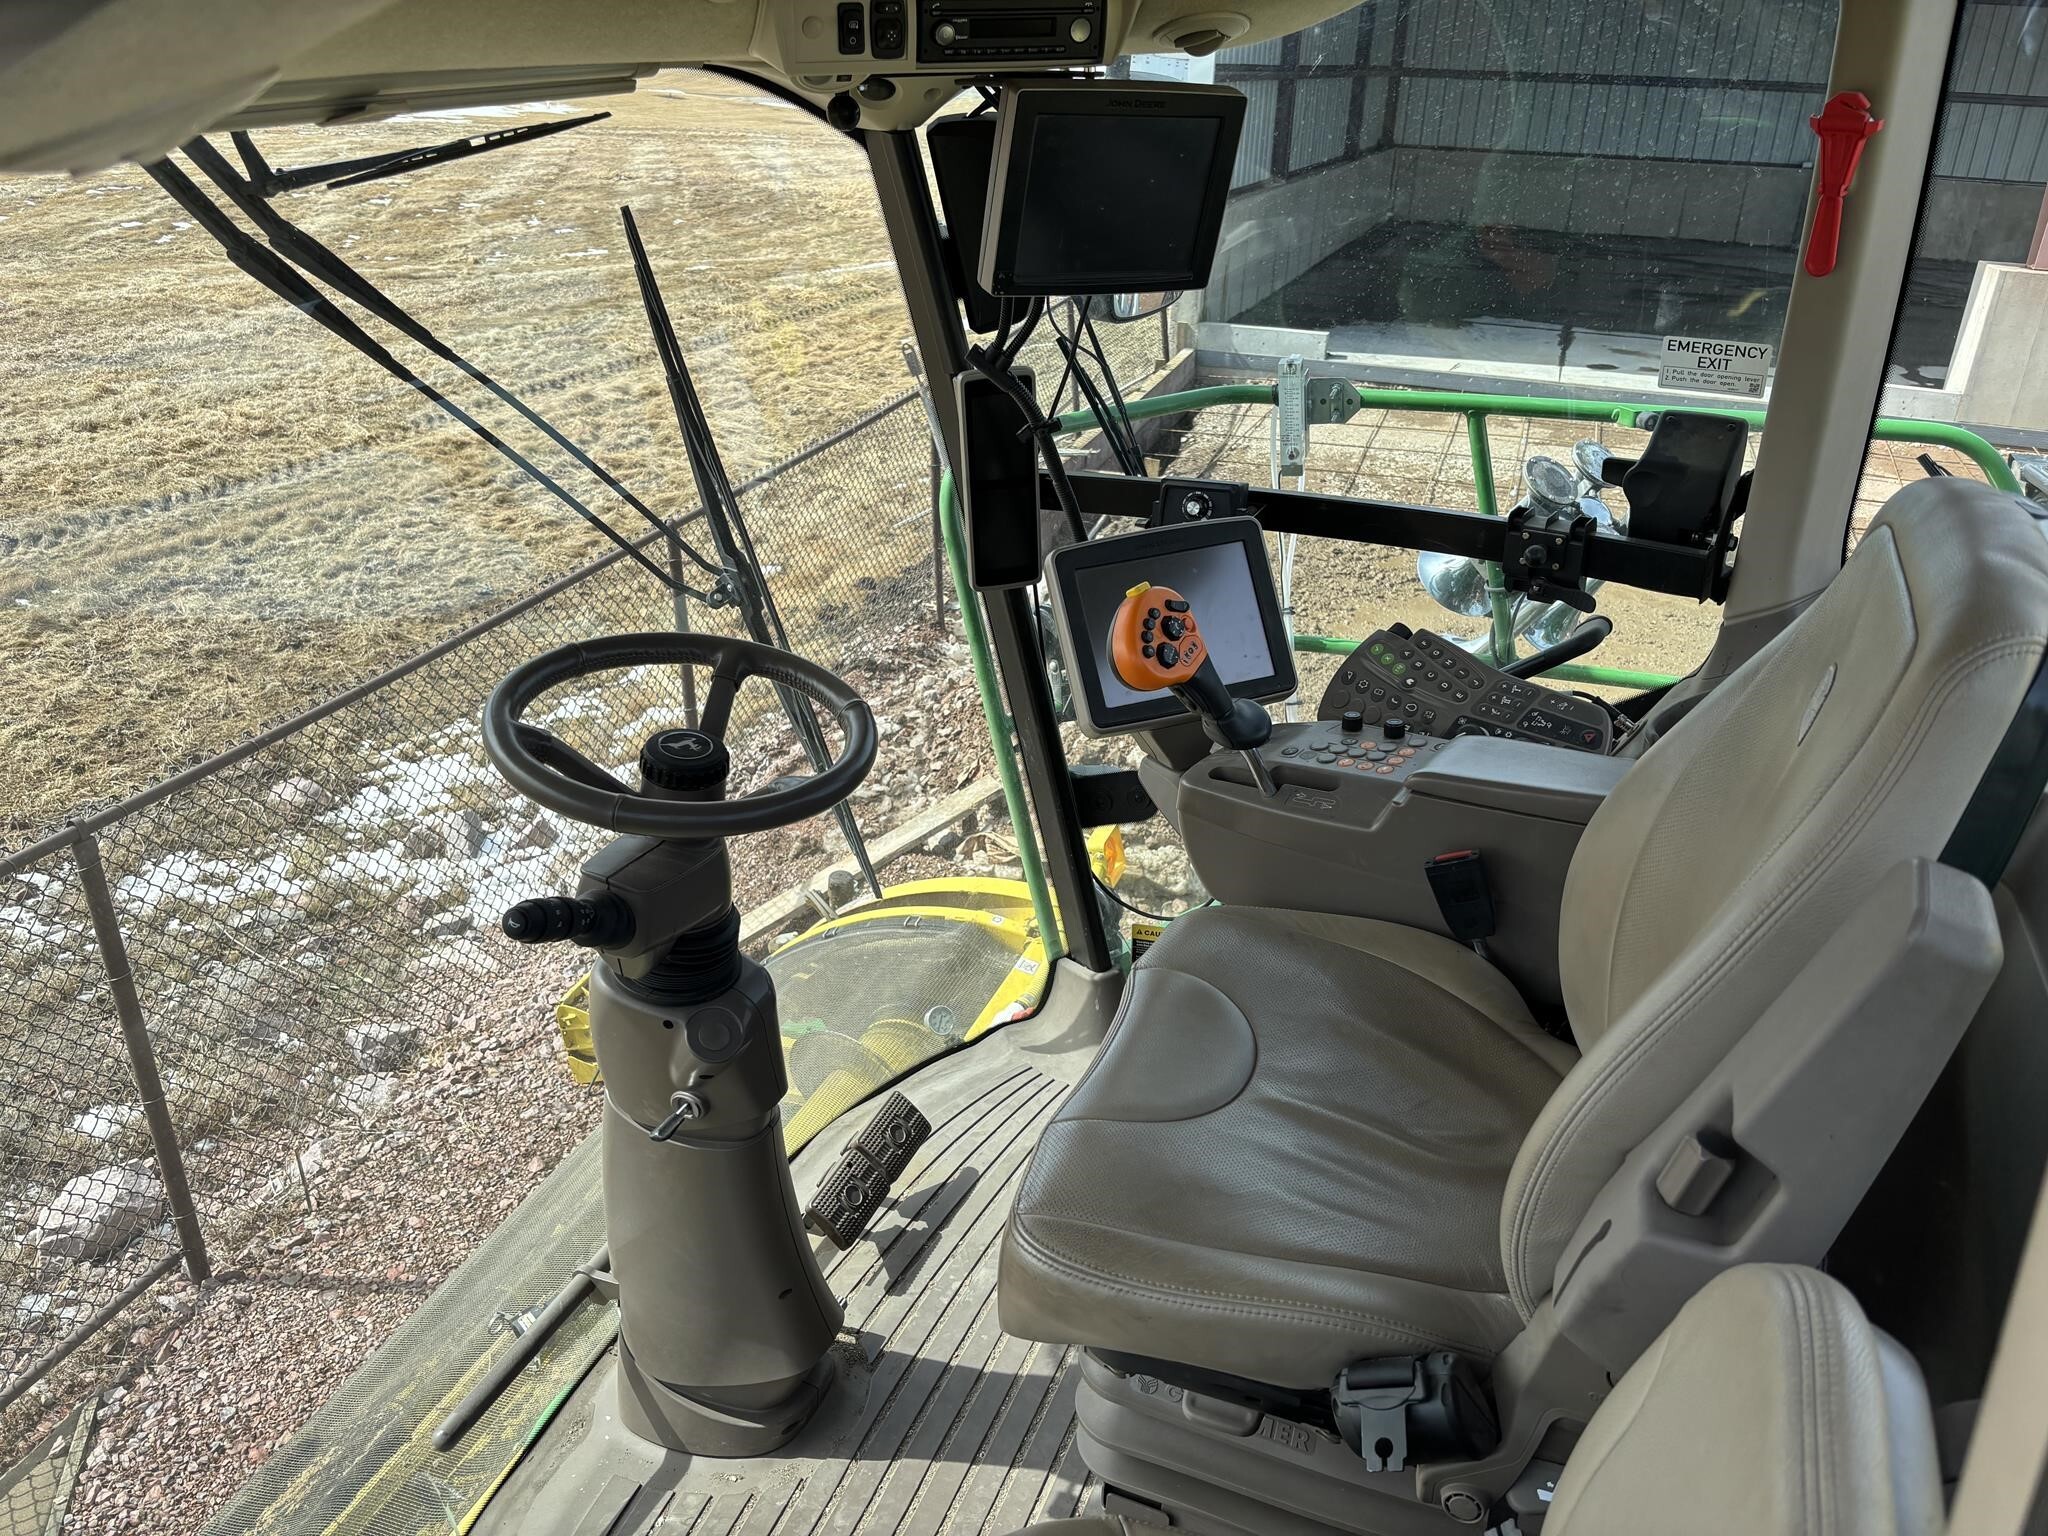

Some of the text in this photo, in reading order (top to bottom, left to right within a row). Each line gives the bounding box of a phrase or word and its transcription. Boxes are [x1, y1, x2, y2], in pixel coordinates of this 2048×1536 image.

[1667, 339, 1768, 359] EMERGENCY
[1697, 356, 1732, 370] EXIT
[1717, 374, 1742, 382] opening
